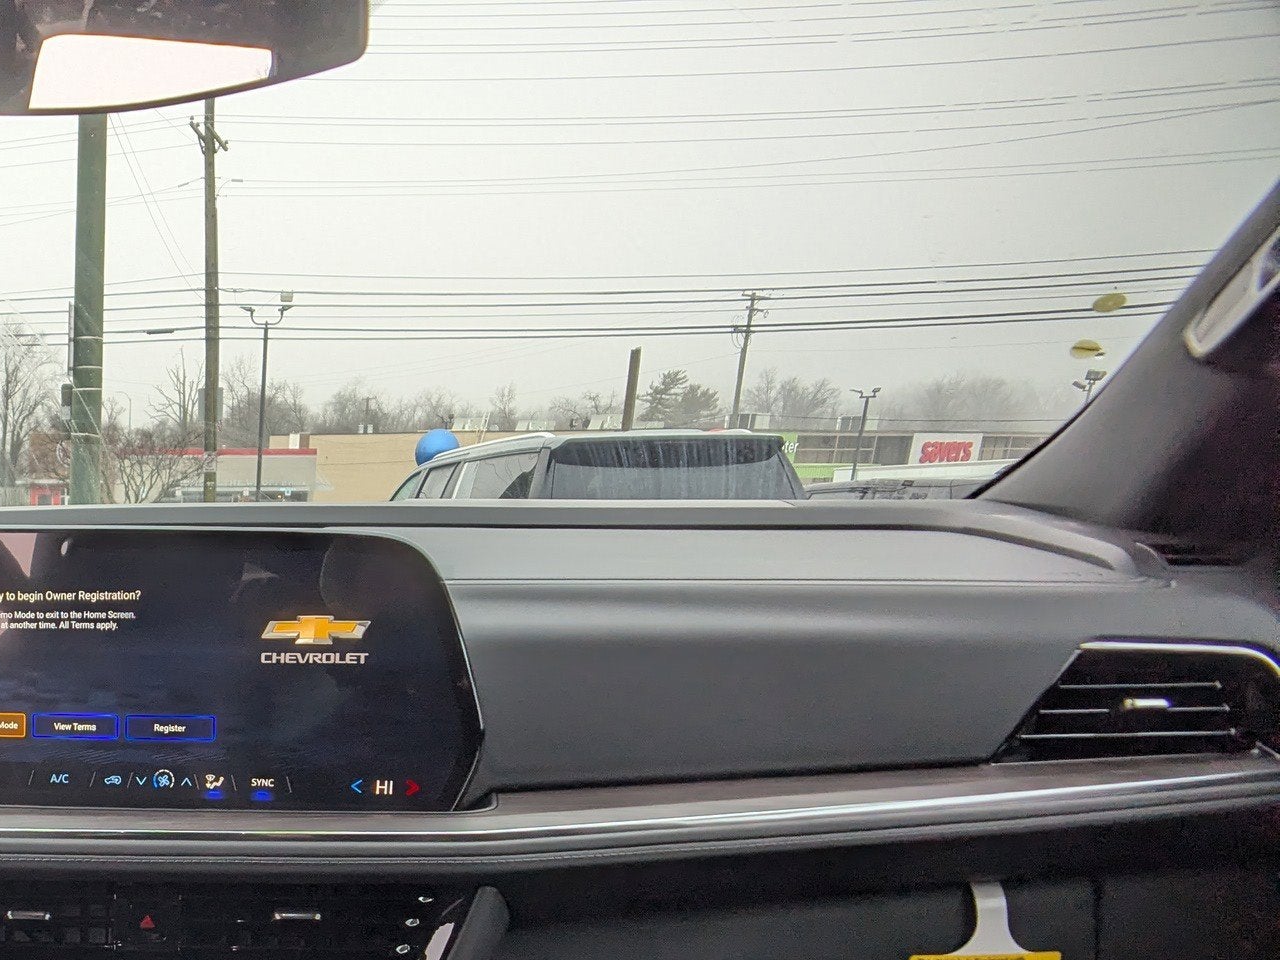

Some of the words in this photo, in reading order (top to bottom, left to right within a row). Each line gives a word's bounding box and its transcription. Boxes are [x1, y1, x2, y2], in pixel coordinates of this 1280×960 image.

[6, 592, 16, 601] to
[17, 591, 44, 603] begin
[45, 591, 76, 601] Owner
[78, 590, 142, 603] Registration?
[14, 611, 36, 619] Mode
[36, 611, 44, 619] to
[45, 611, 59, 619] exit
[60, 611, 68, 619] to
[70, 611, 82, 619] the
[83, 611, 107, 619] Home
[107, 611, 136, 619] Screen.
[0, 621, 8, 629] at
[9, 621, 38, 629] another
[38, 621, 58, 629] time.
[59, 621, 70, 629] All
[70, 621, 95, 629] Terms
[96, 621, 119, 631] apply.
[260, 652, 369, 665] CHEVROLET
[53, 722, 72, 731] View
[73, 722, 97, 732] Terms
[153, 723, 187, 735] Register
[49, 773, 69, 784] A/C
[250, 777, 275, 788] SYNC
[375, 779, 394, 795] HI
